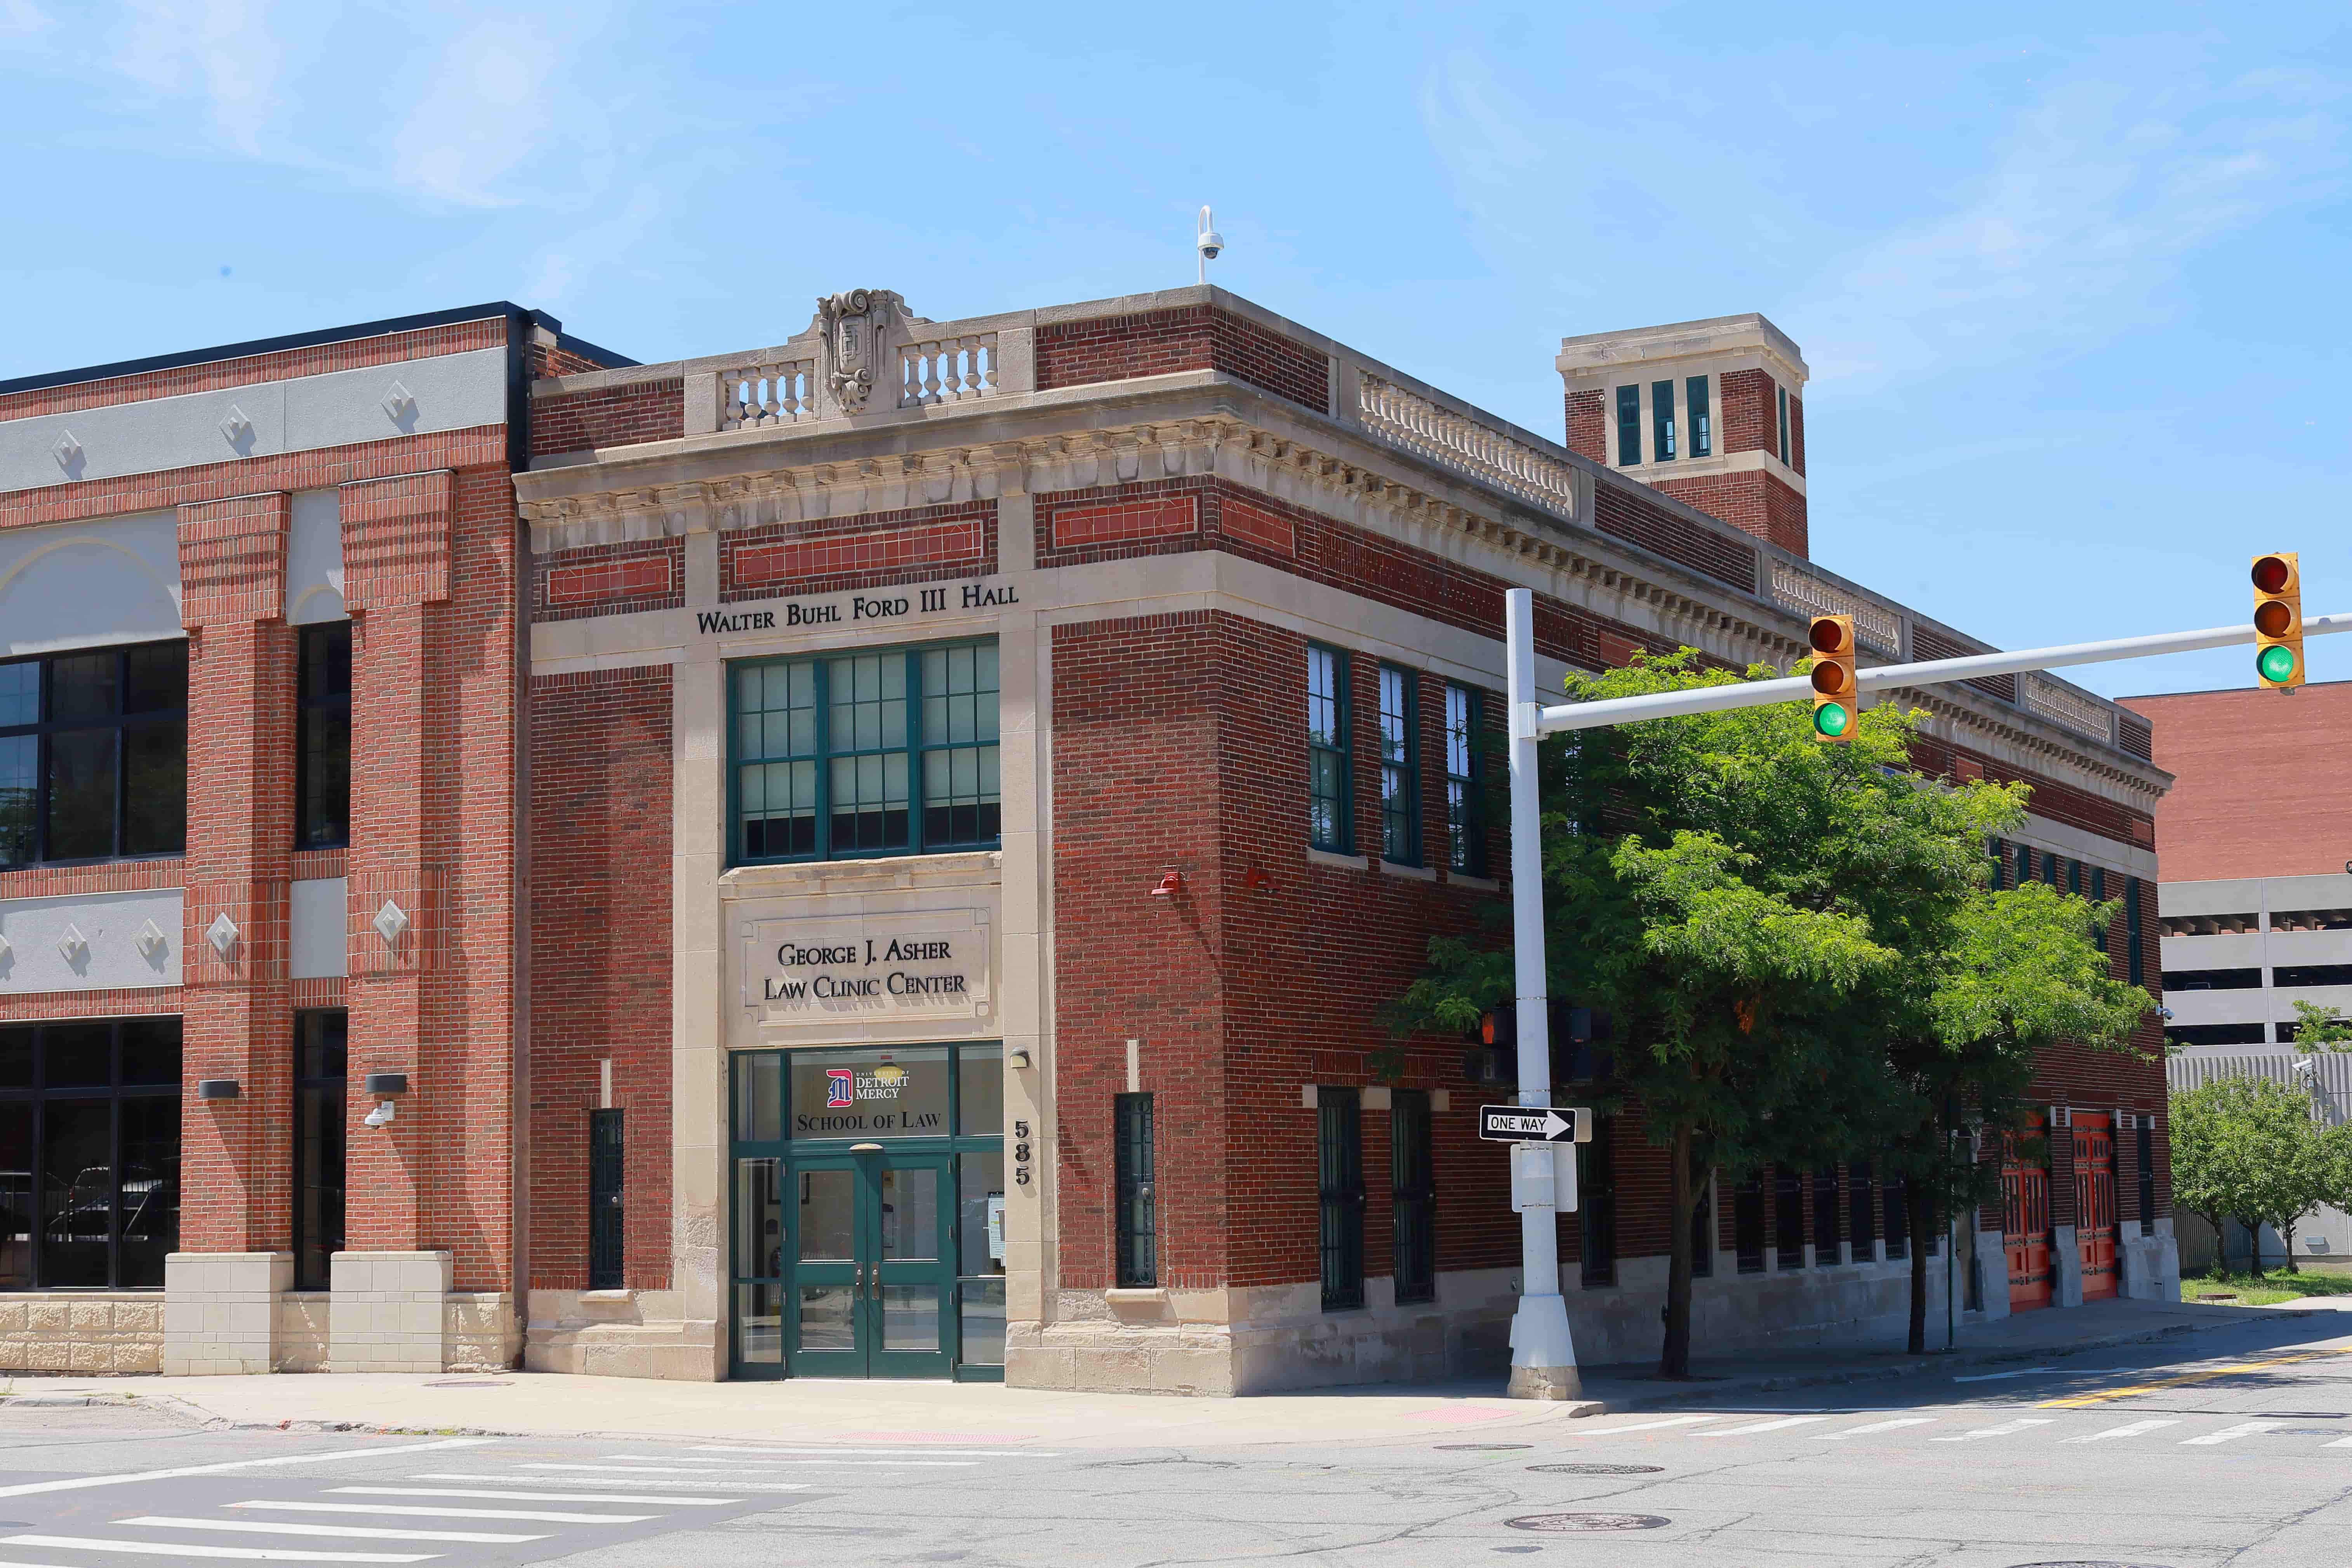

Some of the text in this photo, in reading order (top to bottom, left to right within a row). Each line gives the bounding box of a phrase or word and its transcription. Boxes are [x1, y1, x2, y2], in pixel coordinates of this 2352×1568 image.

[920, 589, 946, 612] III
[865, 940, 877, 966] J.
[856, 1076, 909, 1088] DETROIT
[856, 1088, 899, 1100] MERCY
[873, 1115, 895, 1129] OF
[1491, 1117, 1546, 1131] ONE WAY
